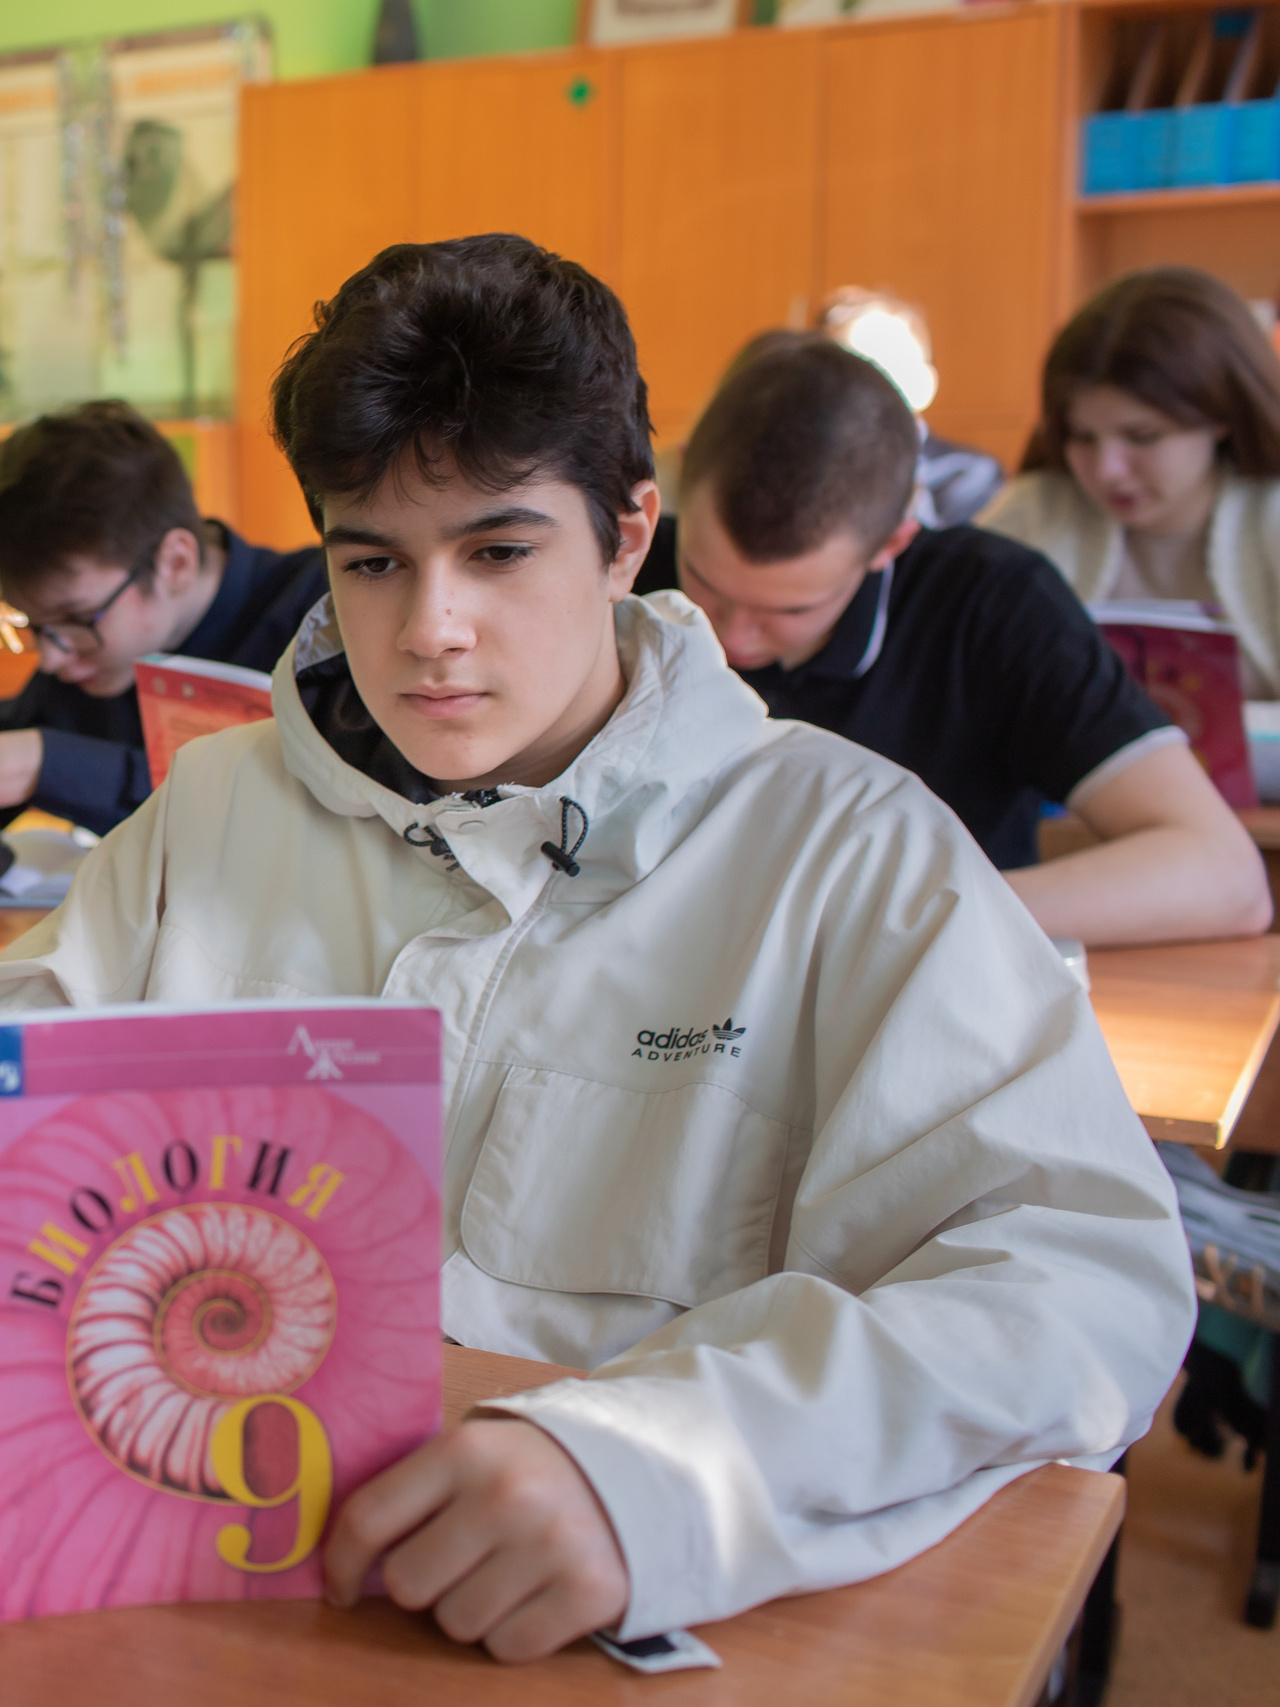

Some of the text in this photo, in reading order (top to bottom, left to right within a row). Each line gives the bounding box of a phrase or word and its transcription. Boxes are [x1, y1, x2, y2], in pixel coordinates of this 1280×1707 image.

[631, 1043, 742, 1062] ADVENTURE
[636, 1027, 709, 1049] adidas
[10, 1135, 345, 1309] БИОЛОГИЯ
[211, 1393, 334, 1574] 9
